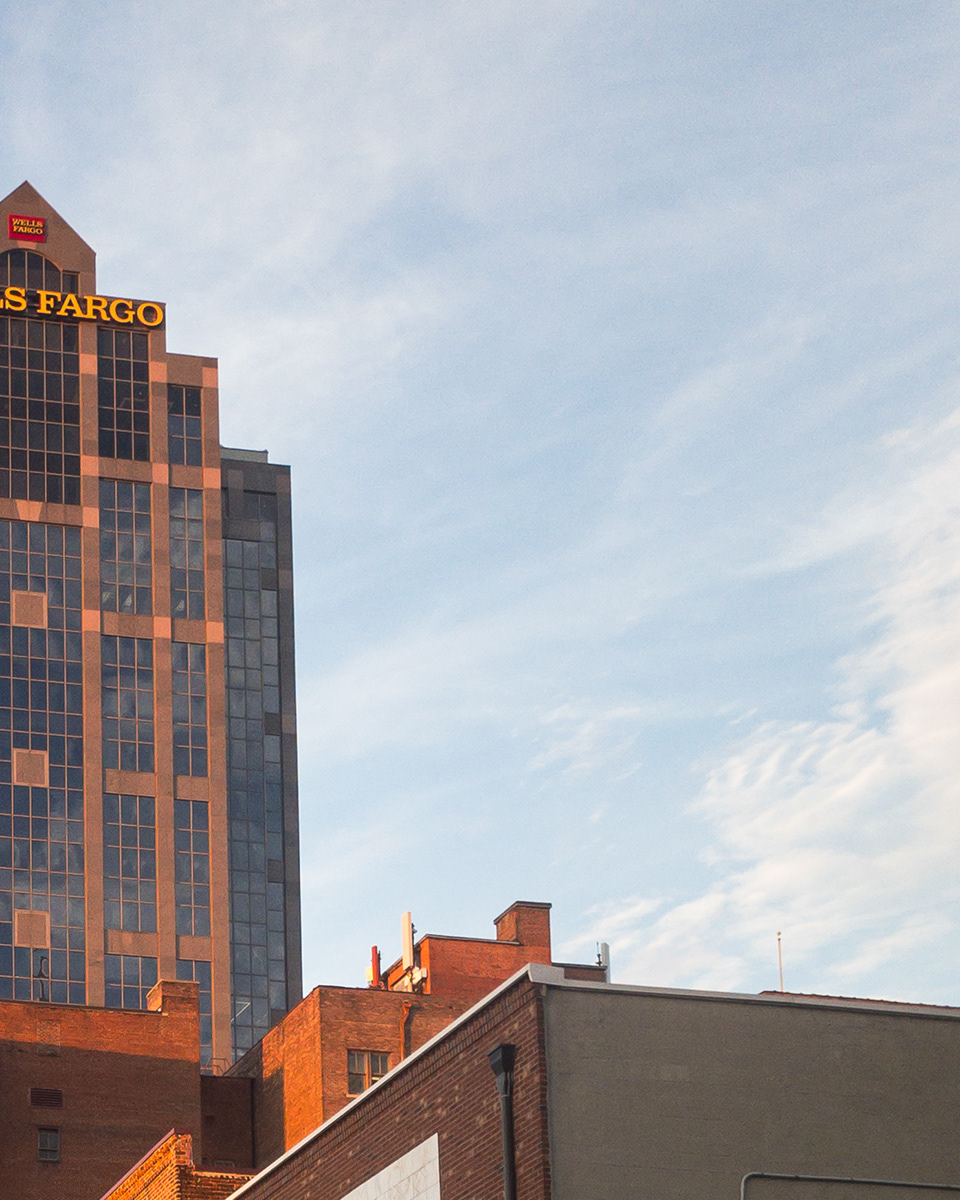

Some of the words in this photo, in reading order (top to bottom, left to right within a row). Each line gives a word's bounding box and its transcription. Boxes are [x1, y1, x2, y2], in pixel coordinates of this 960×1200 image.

[11, 217, 44, 228] WELLS
[12, 225, 44, 235] FARGO
[36, 289, 164, 327] FARGO
